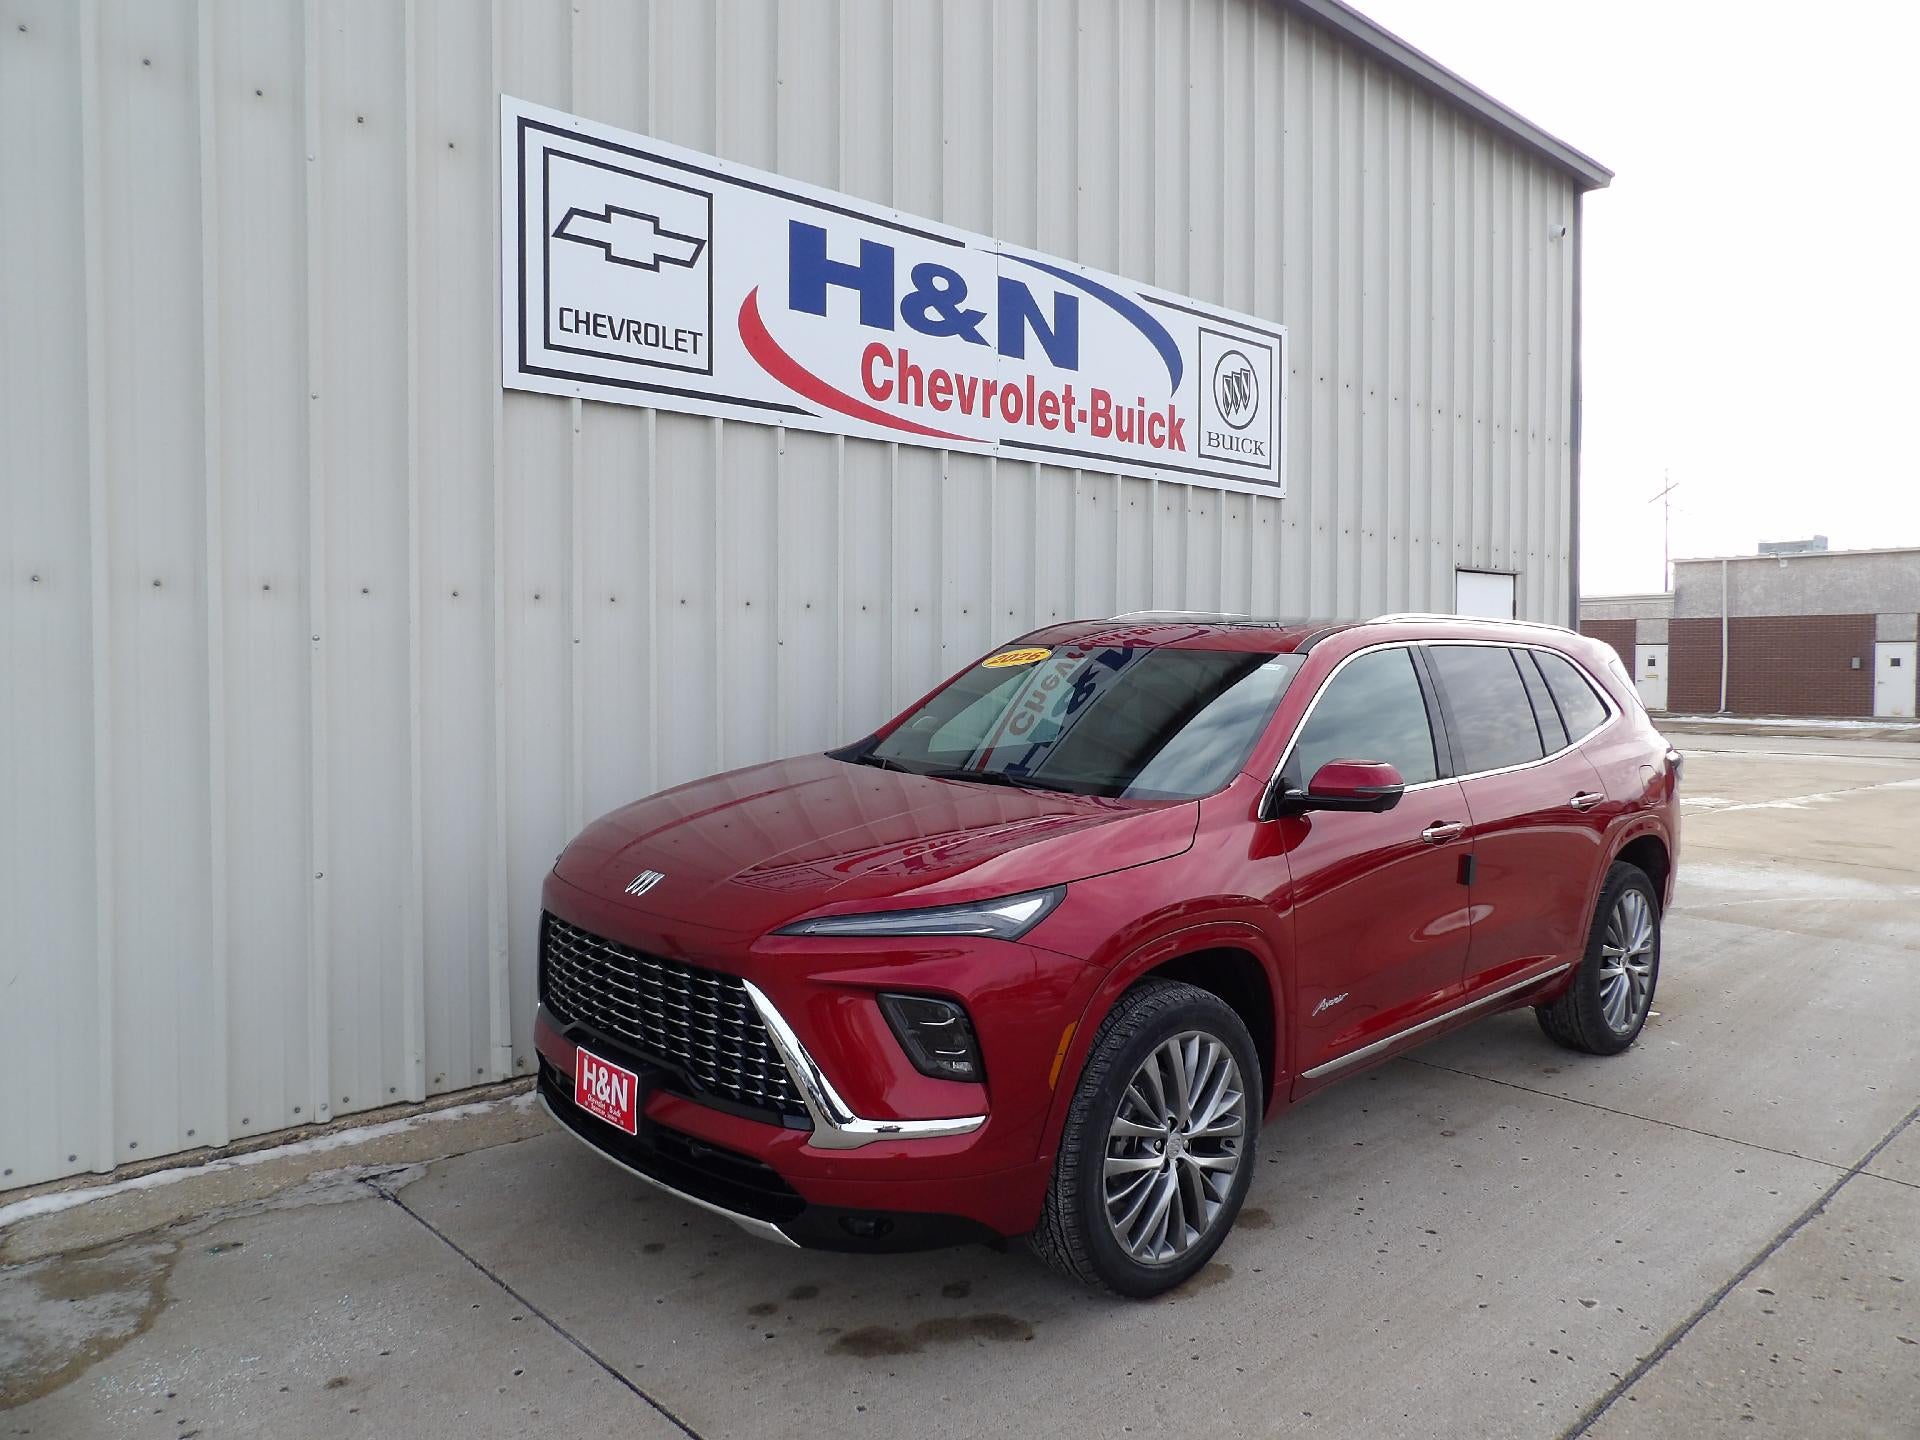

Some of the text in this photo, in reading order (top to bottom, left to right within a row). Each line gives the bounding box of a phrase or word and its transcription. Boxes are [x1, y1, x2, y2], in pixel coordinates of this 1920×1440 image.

[789, 219, 1079, 371] H&N
[559, 306, 703, 355] CHEVROLET
[861, 342, 1186, 453] Chevrolet-Buick
[1206, 431, 1266, 457] BUICK
[988, 652, 1046, 665] 2026
[583, 1058, 628, 1112] H&N
